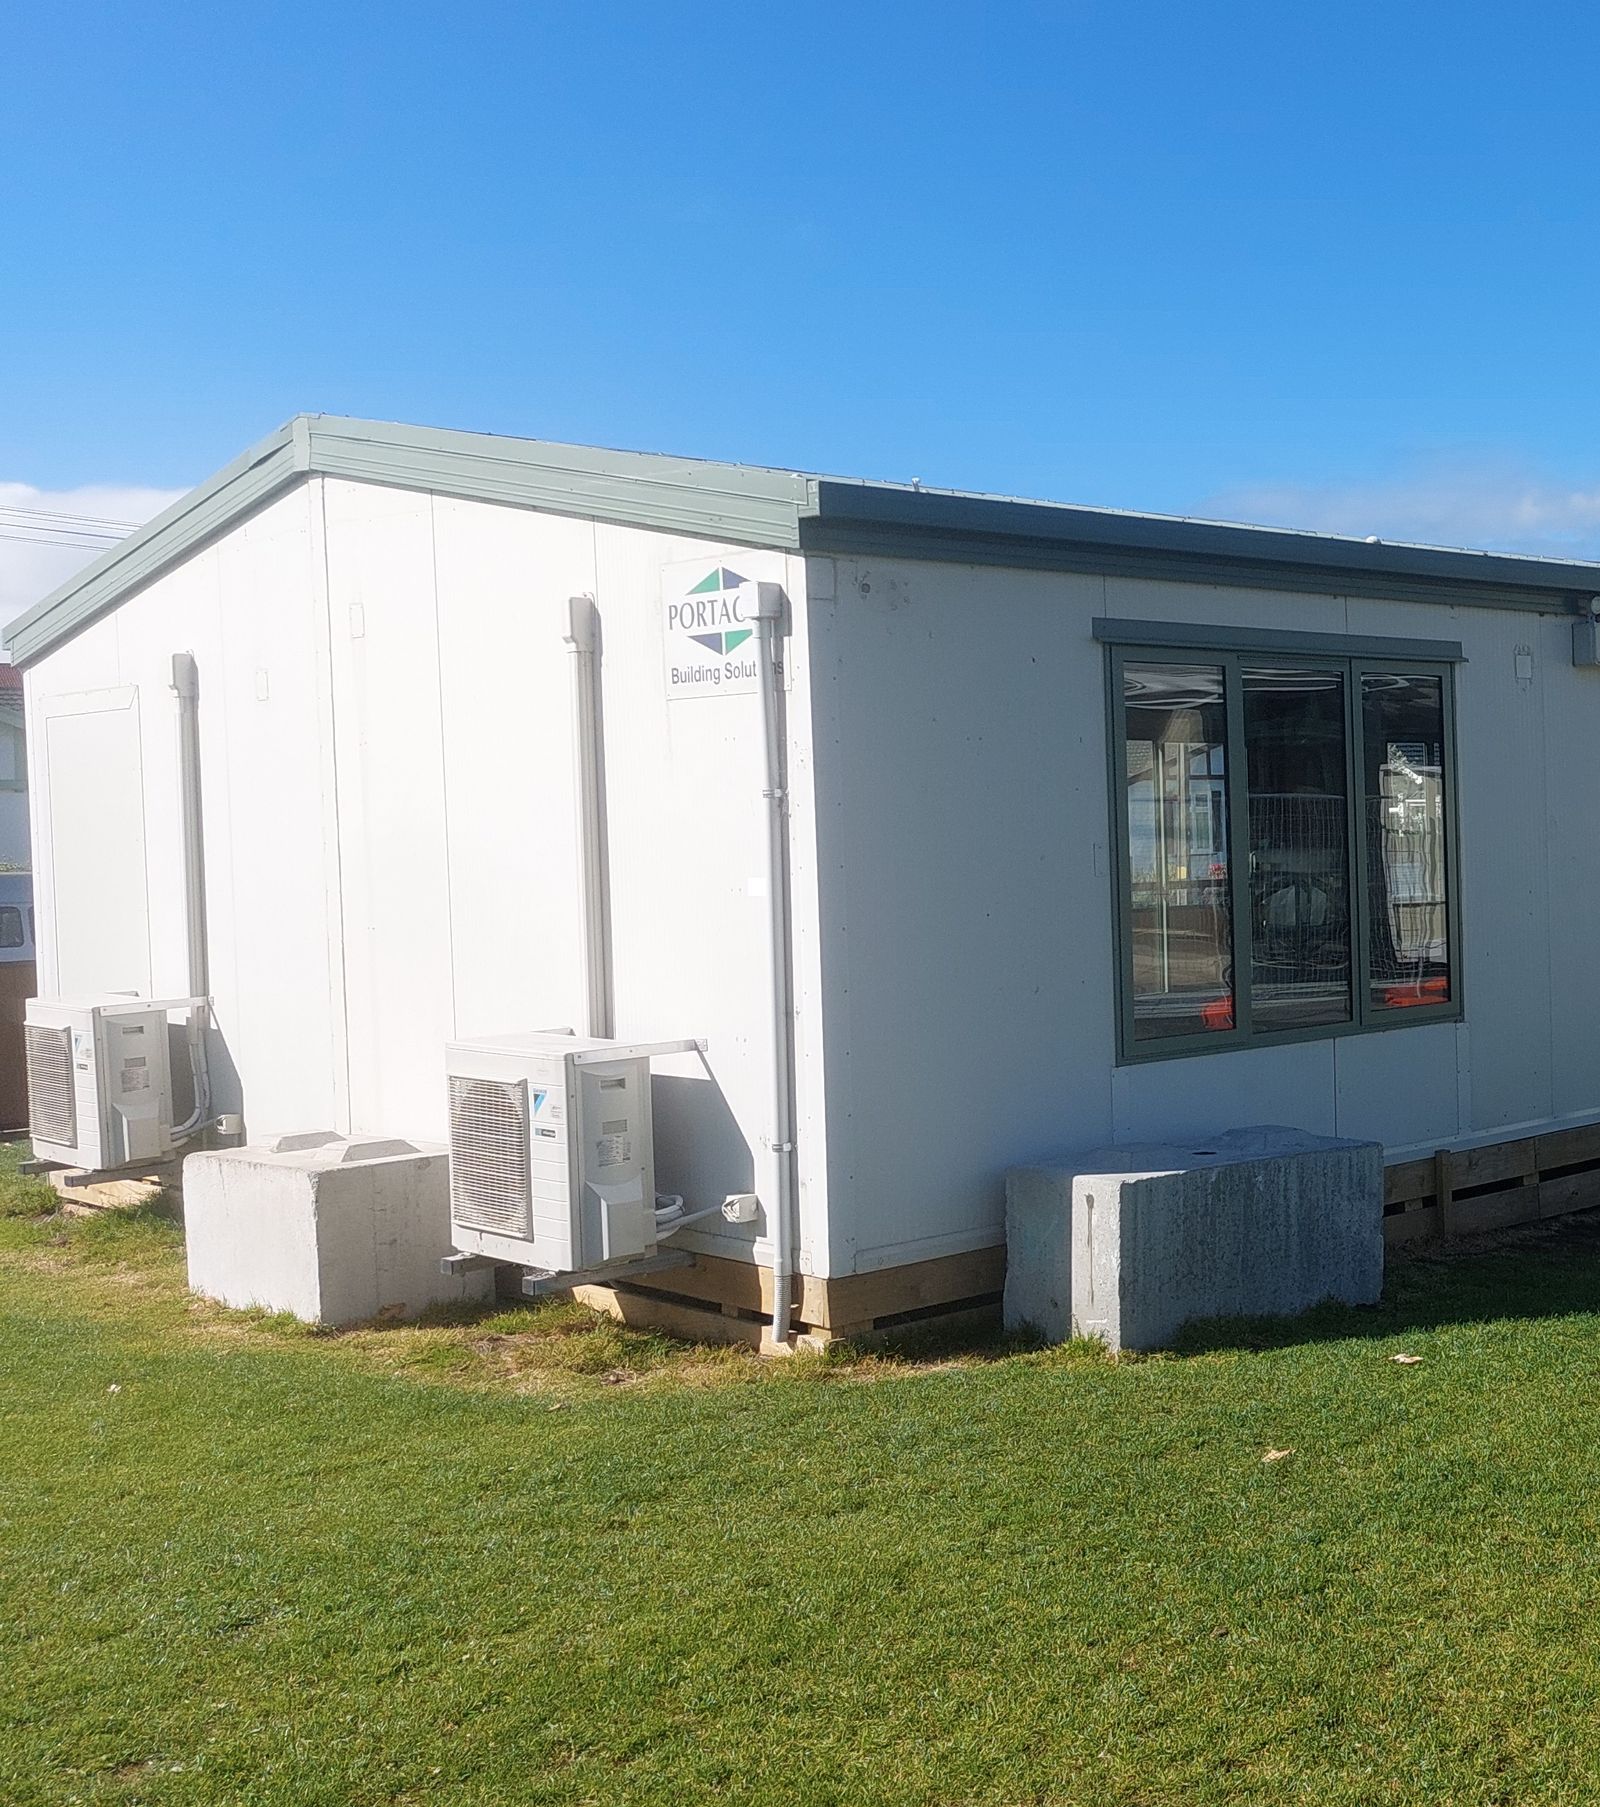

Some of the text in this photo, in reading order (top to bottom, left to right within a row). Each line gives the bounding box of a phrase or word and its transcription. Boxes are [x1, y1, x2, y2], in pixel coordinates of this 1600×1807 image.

[668, 595, 745, 631] PORTAC
[671, 660, 785, 685] Building Solutns
